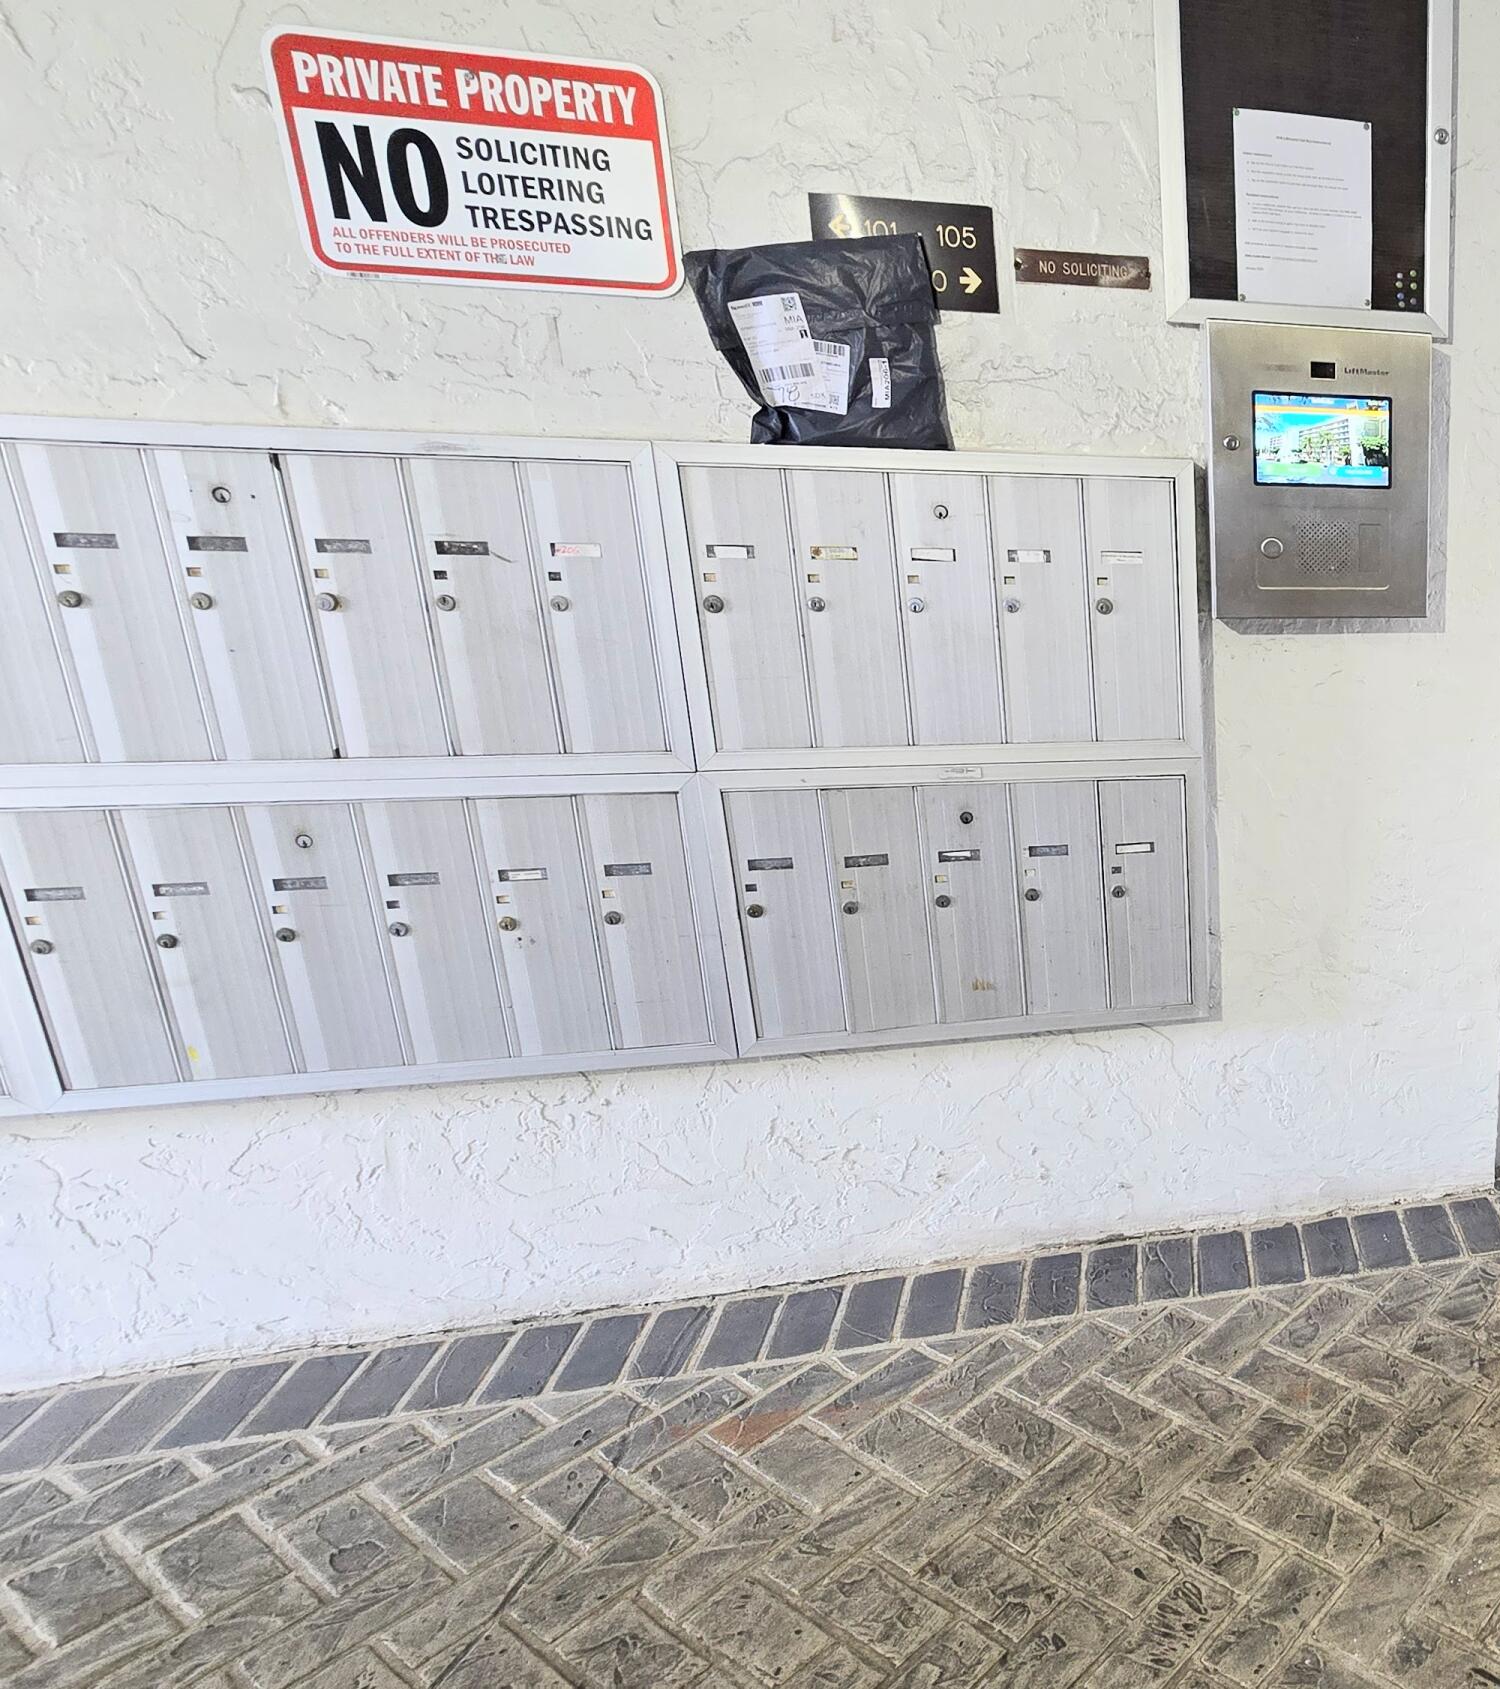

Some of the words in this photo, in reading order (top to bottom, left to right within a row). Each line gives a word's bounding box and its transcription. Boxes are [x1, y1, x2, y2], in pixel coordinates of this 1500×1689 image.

[290, 50, 448, 109] PRIVATE
[454, 68, 637, 126] PROPERTY
[456, 136, 612, 172] SOLICITING
[314, 120, 449, 229] NO
[461, 171, 605, 205] LOITERING
[465, 205, 653, 241] TRESPASSING
[935, 224, 977, 249] 105
[332, 226, 356, 239] ALL
[359, 228, 435, 244] OFFENDERS
[437, 234, 469, 247] WILL
[471, 237, 487, 249] BE
[490, 239, 571, 254] PROSECUTED
[335, 242, 352, 253] TO
[354, 242, 380, 256] THE
[383, 244, 413, 258] FULL
[417, 247, 461, 262] EXTENT
[464, 251, 481, 263] OF
[483, 252, 508, 265] THE
[509, 254, 535, 266] LAW
[1039, 260, 1056, 275] NO
[1062, 262, 1128, 279] SOLICITING
[1344, 367, 1390, 376] LiftMaster
